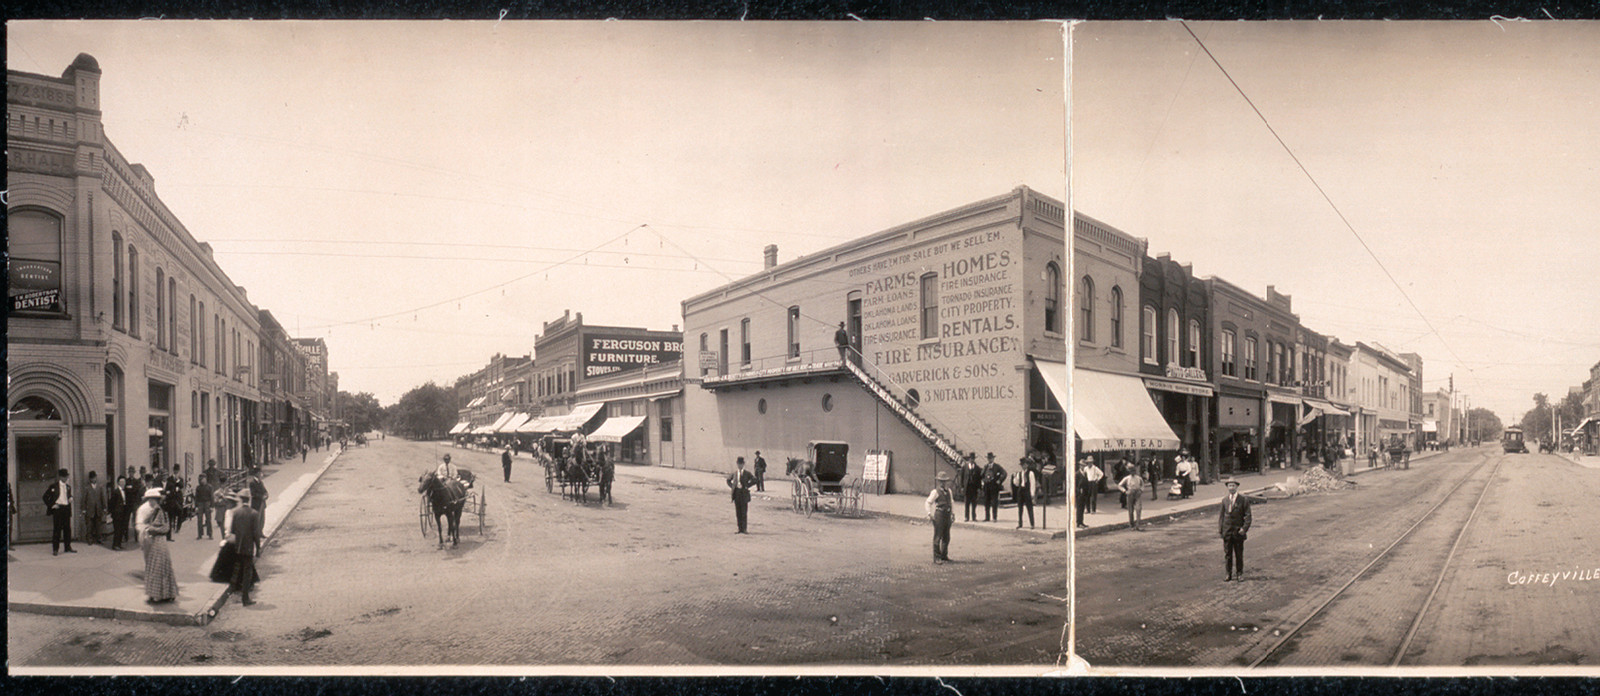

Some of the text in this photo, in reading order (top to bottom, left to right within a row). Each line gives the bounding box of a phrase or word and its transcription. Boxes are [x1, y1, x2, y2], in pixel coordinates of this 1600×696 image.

[849, 264, 872, 278] OTHERS
[873, 260, 888, 270] HAVE
[900, 254, 911, 264] FOR
[913, 248, 931, 261] SALE
[934, 244, 948, 255] BUT
[950, 240, 960, 250] WE
[964, 234, 985, 248] SELL
[941, 280, 959, 292] FIRE
[864, 296, 884, 308] FARM
[941, 292, 972, 304] TORNADO
[864, 306, 896, 319] OKLAHOMA
[941, 306, 960, 318] CITY
[864, 319, 896, 331] OKLAHOMA
[593, 339, 661, 351] FERGUSON
[864, 334, 878, 345] FIRE
[590, 353, 660, 364] FURNITURE.
[874, 347, 911, 366] FIRE
[889, 366, 950, 384] GARVERICK
[953, 366, 961, 379] &
[925, 391, 931, 402] 3
[934, 387, 970, 401] NOTARY
[1104, 440, 1112, 448] H.
[1117, 440, 1126, 448] W.
